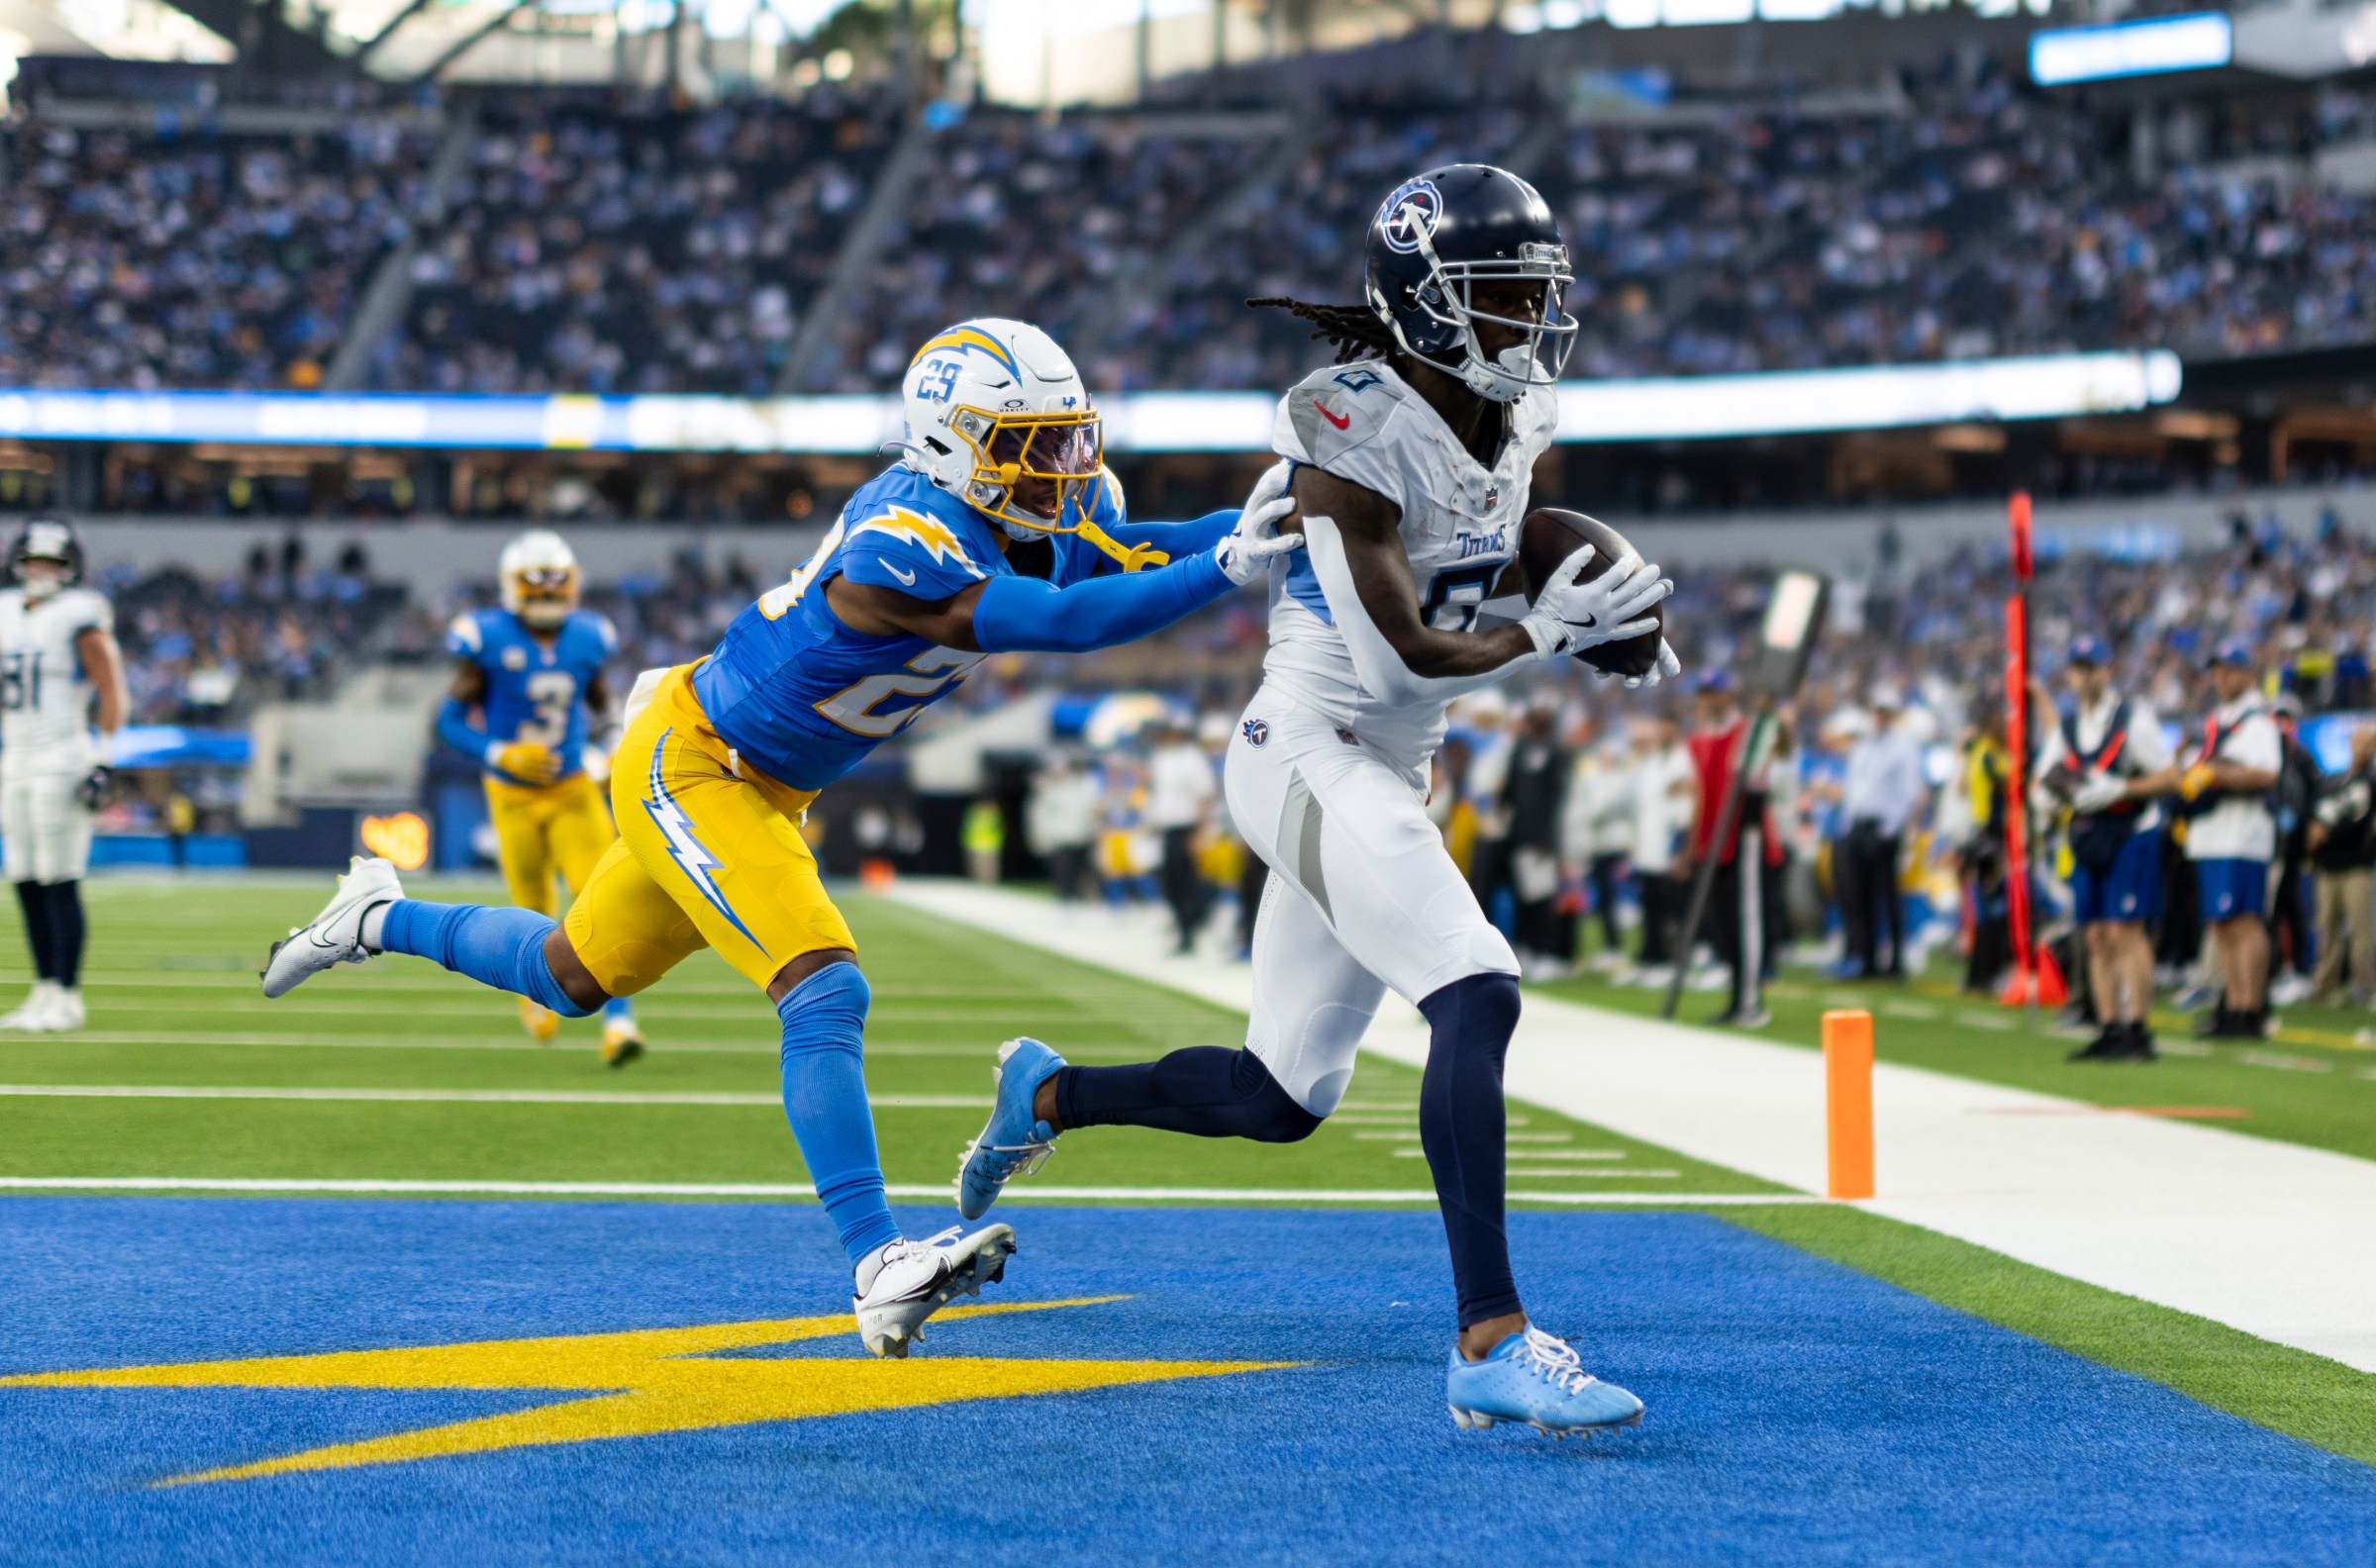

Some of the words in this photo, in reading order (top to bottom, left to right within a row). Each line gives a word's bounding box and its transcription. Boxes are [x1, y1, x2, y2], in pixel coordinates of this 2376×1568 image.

[917, 358, 963, 404] 29
[515, 669, 577, 746] 3
[812, 644, 989, 737] 2
